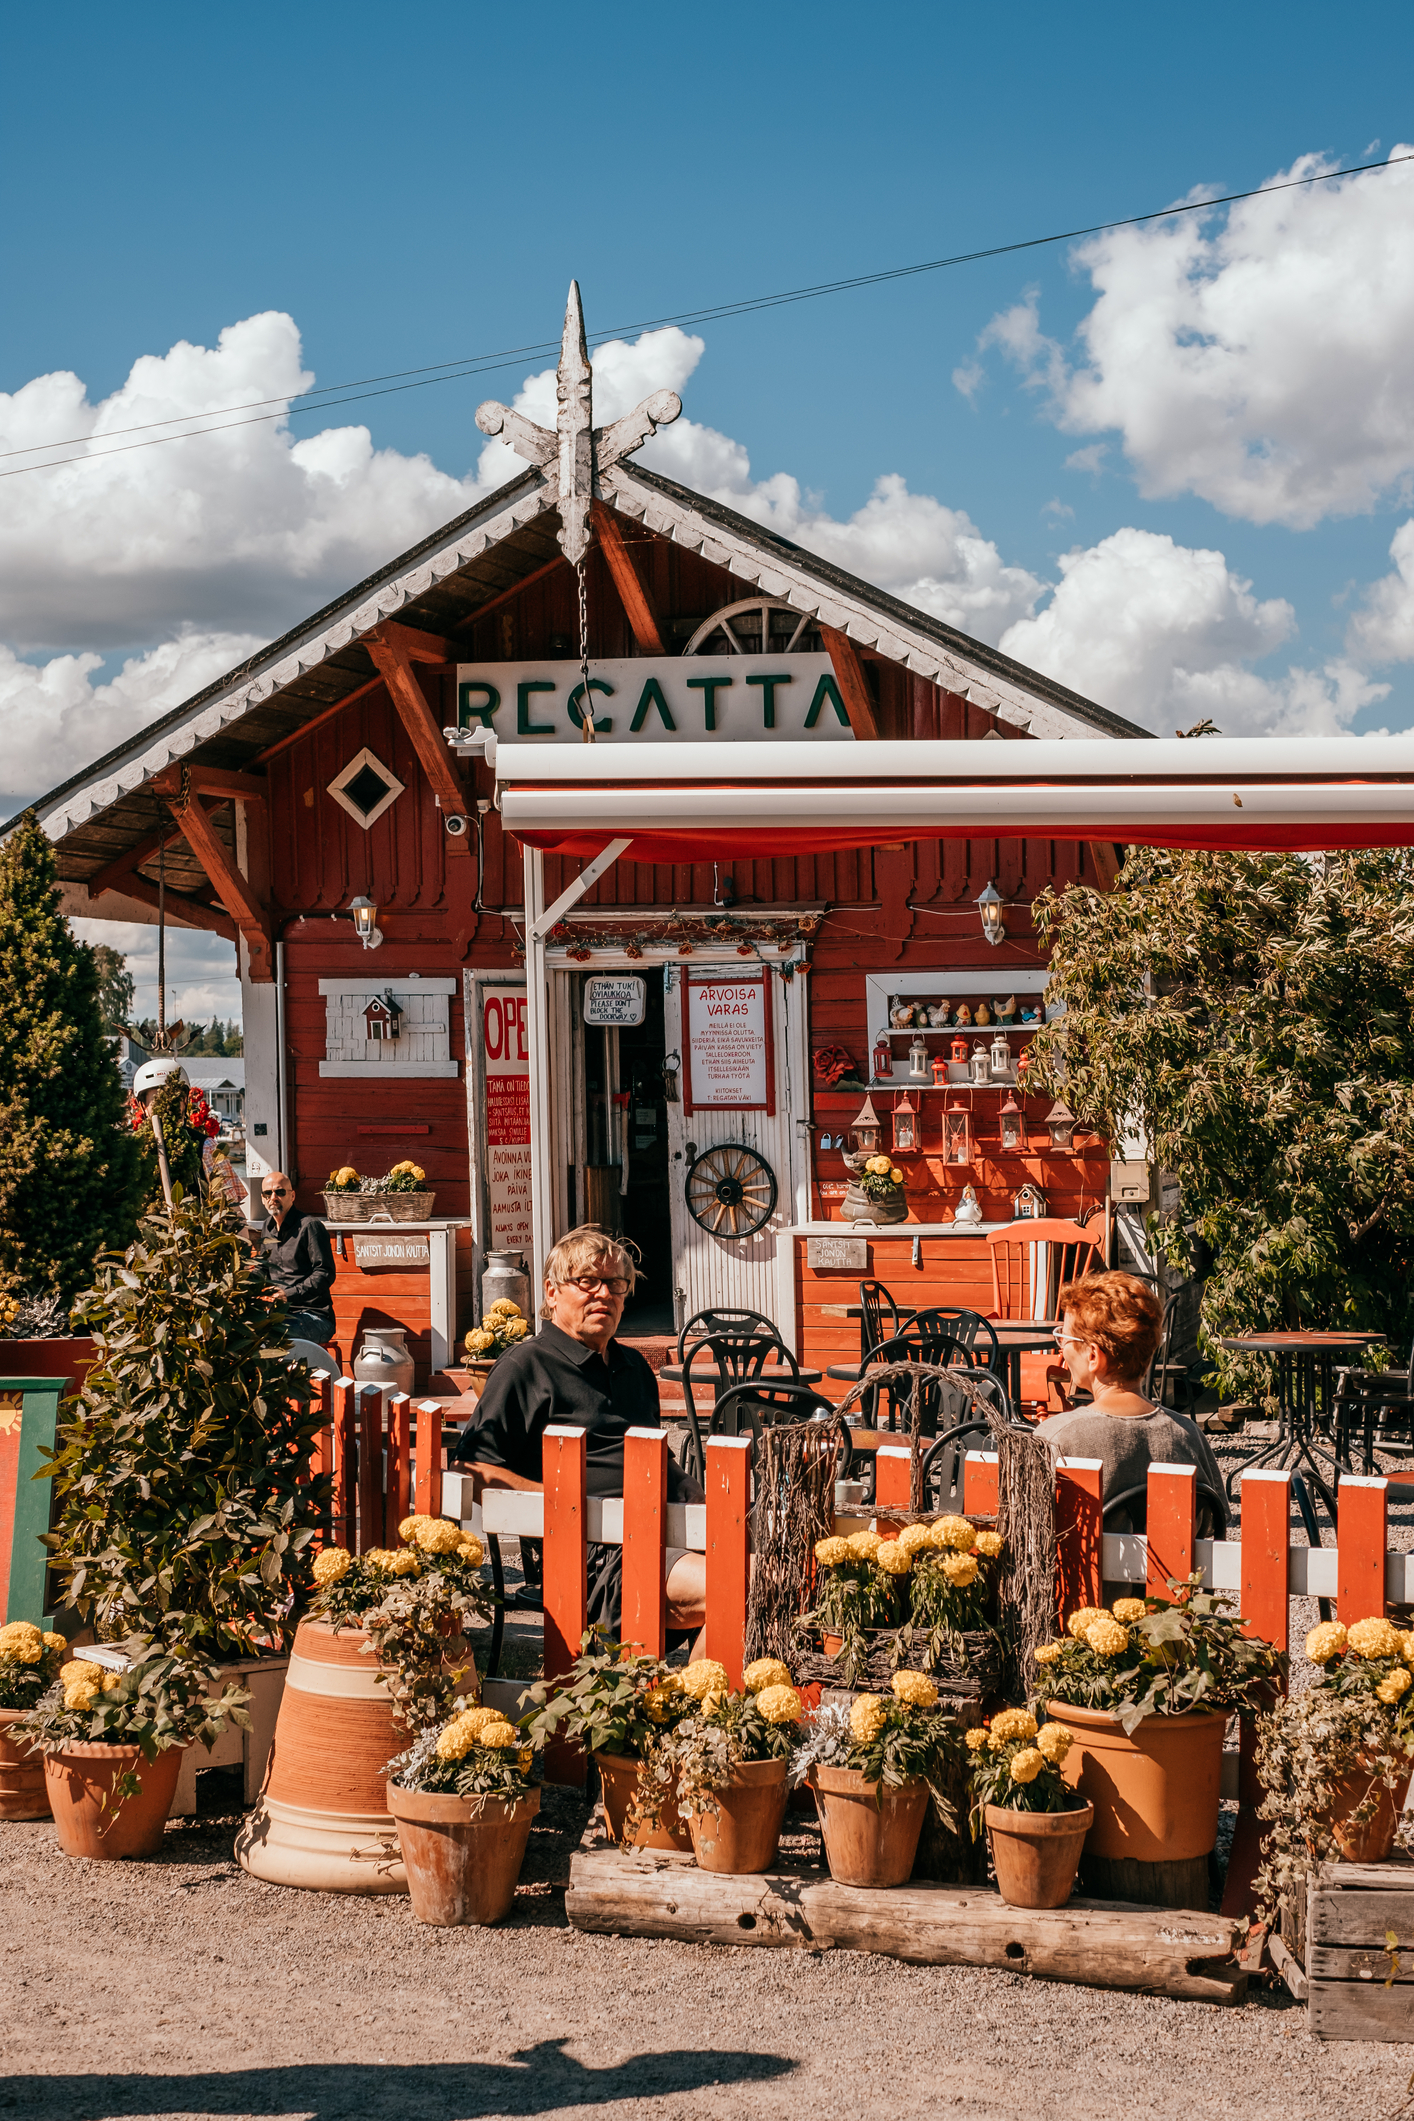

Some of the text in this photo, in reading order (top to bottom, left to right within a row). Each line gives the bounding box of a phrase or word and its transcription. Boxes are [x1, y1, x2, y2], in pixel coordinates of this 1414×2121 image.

[458, 673, 851, 735] REGATTA
[593, 981, 636, 990] ETHÄN TUKI
[699, 988, 756, 1001] ARVOISA
[590, 1000, 613, 1008] PLEASE
[707, 1003, 749, 1016] VARAS
[590, 1007, 608, 1015] BLOCK
[599, 1013, 627, 1021] DOORWAY
[487, 1078, 505, 1093] TÄMÄ
[506, 1080, 515, 1092] ON
[488, 1116, 501, 1127] SIITÄ
[489, 1127, 527, 1136] MAKSAA SINULLE
[493, 1149, 523, 1165] AVOINNA
[492, 1168, 509, 1182] JOKA
[507, 1182, 528, 1195] PÄIVÄ
[493, 1201, 521, 1214] AAMUSTA
[495, 1222, 529, 1233] ALWAYS OPEN
[506, 1235, 523, 1244] EVERY
[815, 1239, 852, 1249] SANTSIT
[356, 1244, 430, 1259] SANTSIT JONON KAUTTA
[819, 1248, 846, 1258] JONON
[817, 1258, 852, 1266] KAUTTA
